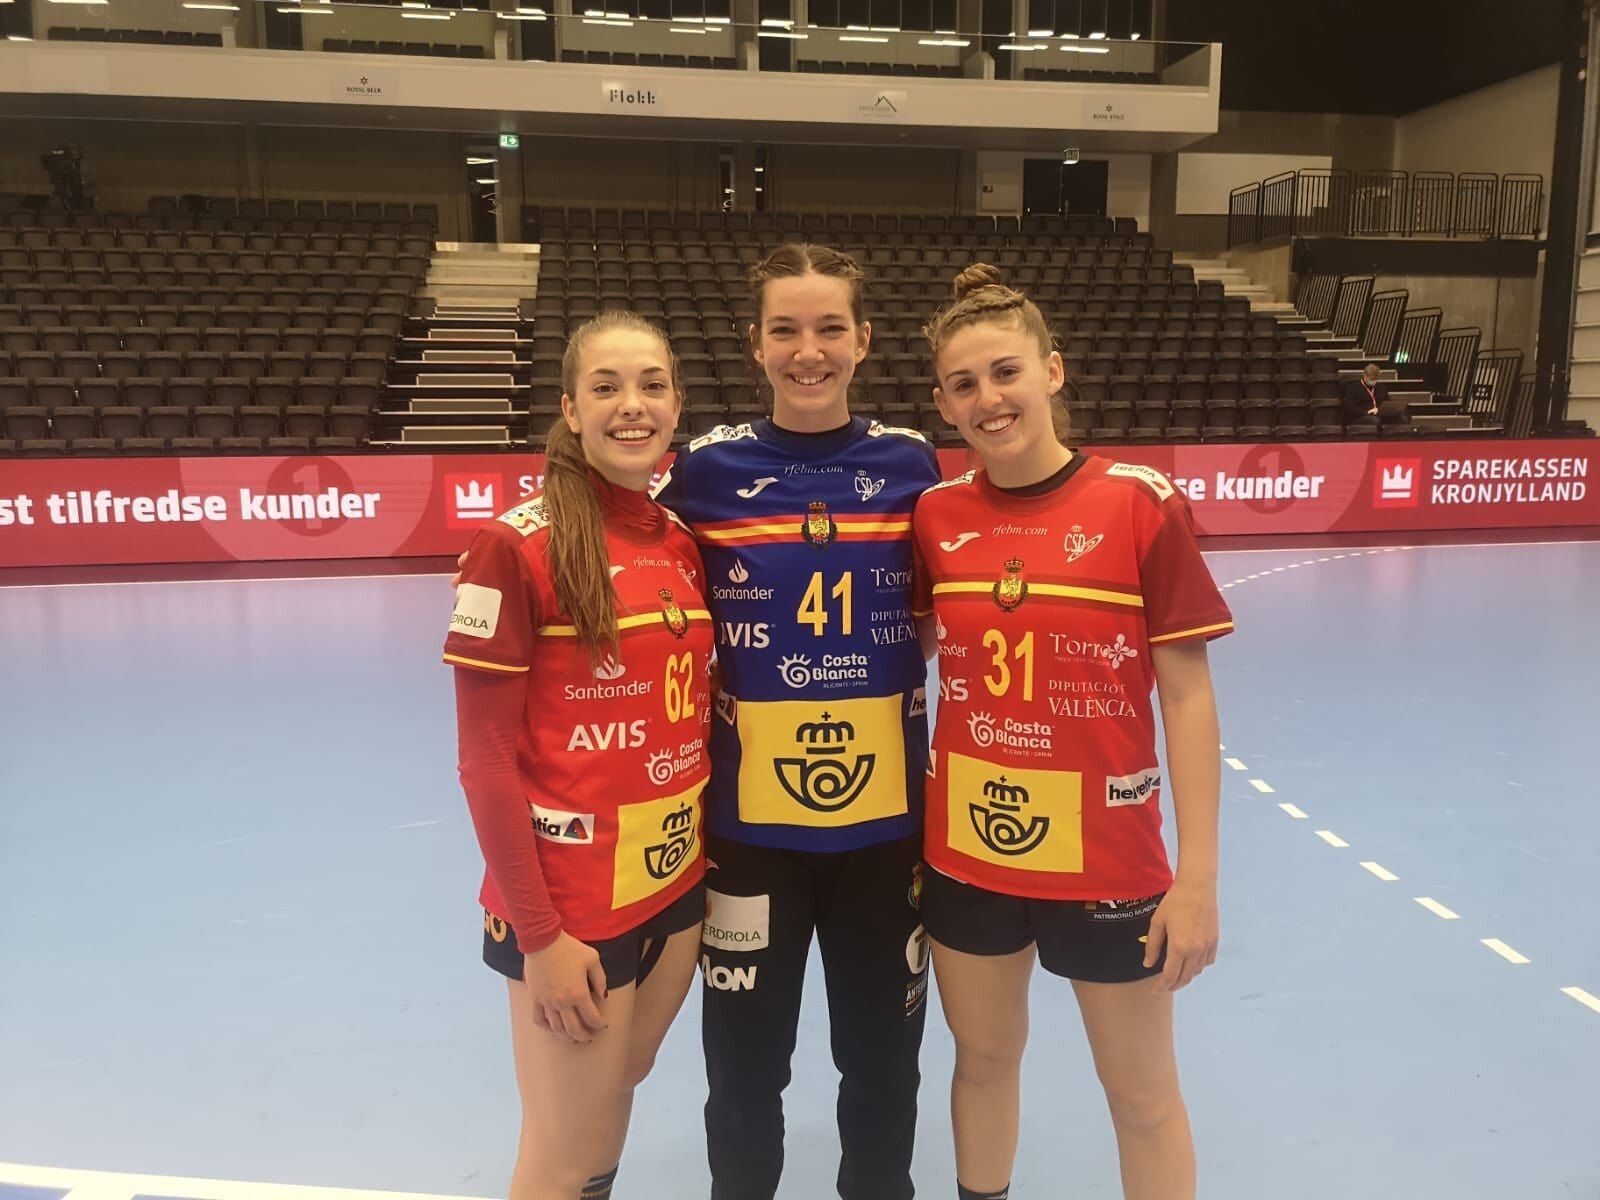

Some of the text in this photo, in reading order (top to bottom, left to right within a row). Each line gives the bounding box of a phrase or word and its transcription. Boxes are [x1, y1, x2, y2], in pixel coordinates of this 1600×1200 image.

[784, 464, 843, 477] rfebm.com
[1432, 458, 1588, 480] SPAREKASSEN
[1215, 471, 1325, 500] kunder
[1431, 482, 1586, 504] KRONJYLLAND
[47, 490, 227, 524] tilfredse
[240, 487, 381, 520] kunder
[992, 524, 1048, 536] rfebm.com
[712, 585, 775, 601] Santander
[797, 571, 853, 637] 41
[822, 653, 869, 667] Costa
[982, 629, 1034, 702] 31
[812, 668, 869, 681] Blanca
[564, 680, 654, 700] Santander
[665, 650, 695, 723] 62
[1048, 695, 1137, 718] VALÈNCIA
[566, 719, 647, 752] AVIS
[1004, 717, 1052, 736] Costa
[680, 738, 703, 757] Costa
[995, 729, 1052, 749] Blanca
[673, 751, 701, 774] Blanca
[1093, 912, 1134, 920] PATRIMONIO
